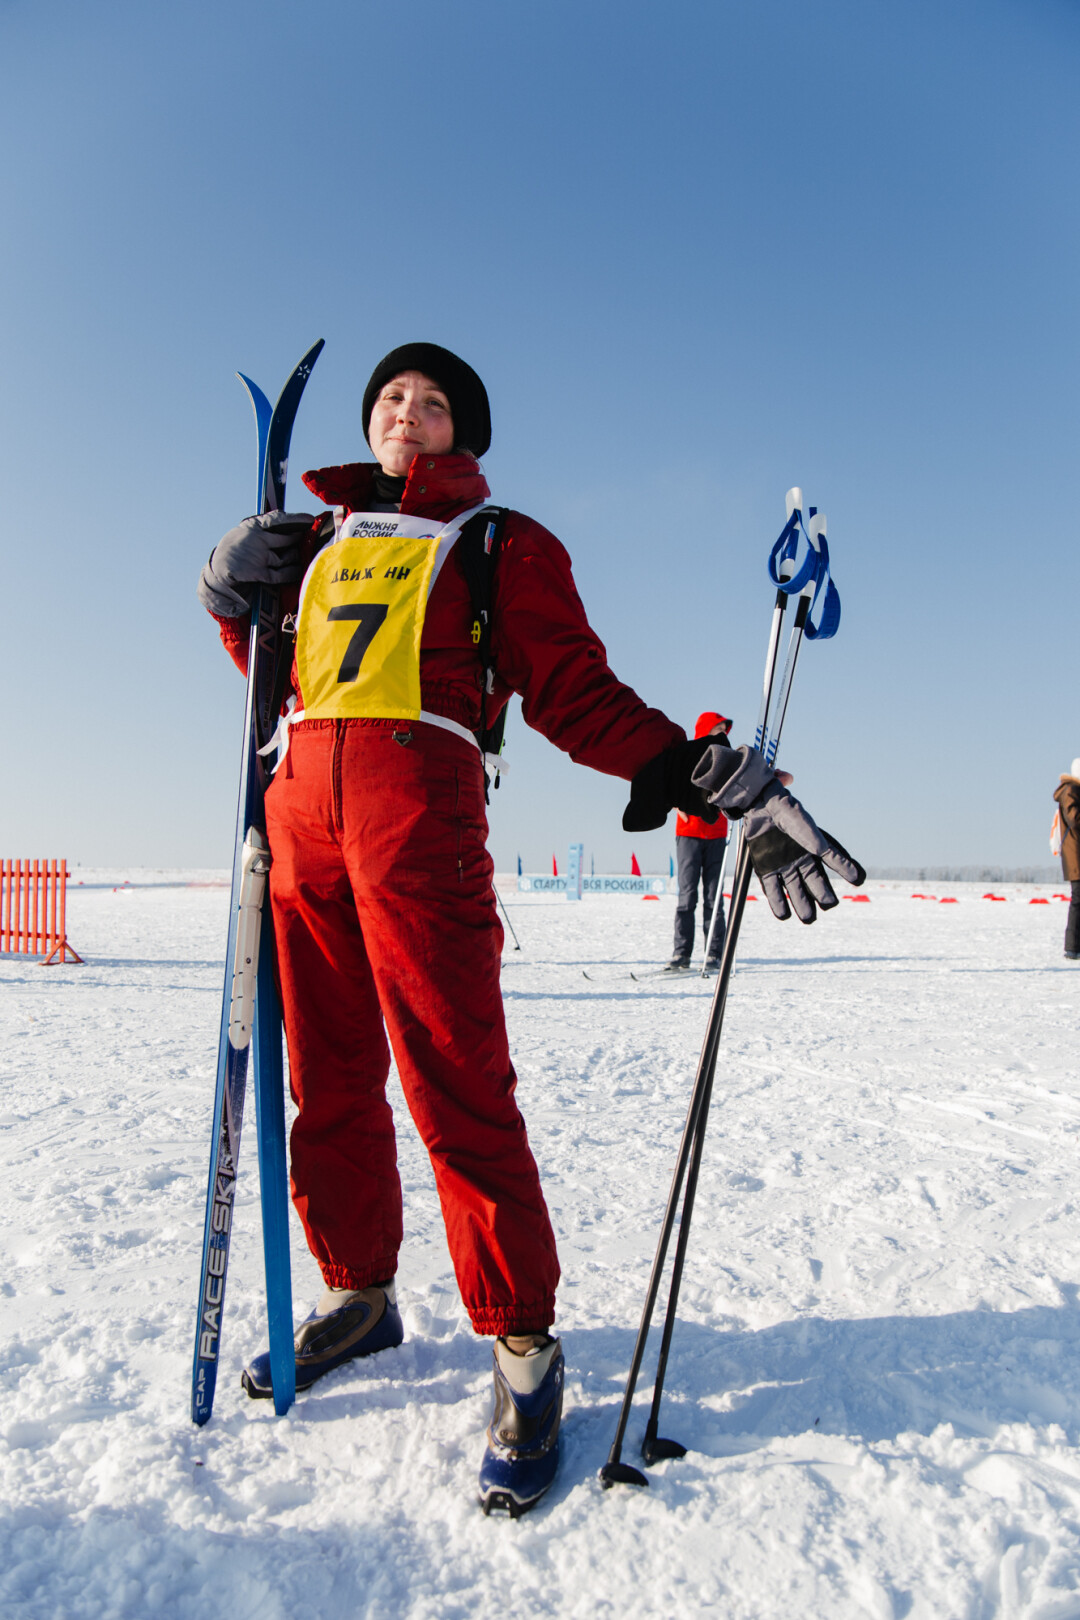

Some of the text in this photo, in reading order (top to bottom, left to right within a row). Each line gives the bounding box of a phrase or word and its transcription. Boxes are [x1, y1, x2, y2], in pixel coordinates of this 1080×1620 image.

[352, 528, 395, 538] РОССИИ
[355, 520, 399, 532] ЛЫЖНЯ
[326, 603, 389, 684] 7
[533, 879, 568, 890] СТАРТУ
[583, 879, 602, 890] ВСЯ
[199, 1166, 236, 1361] RACE SKI
[195, 1367, 206, 1407] CAP
